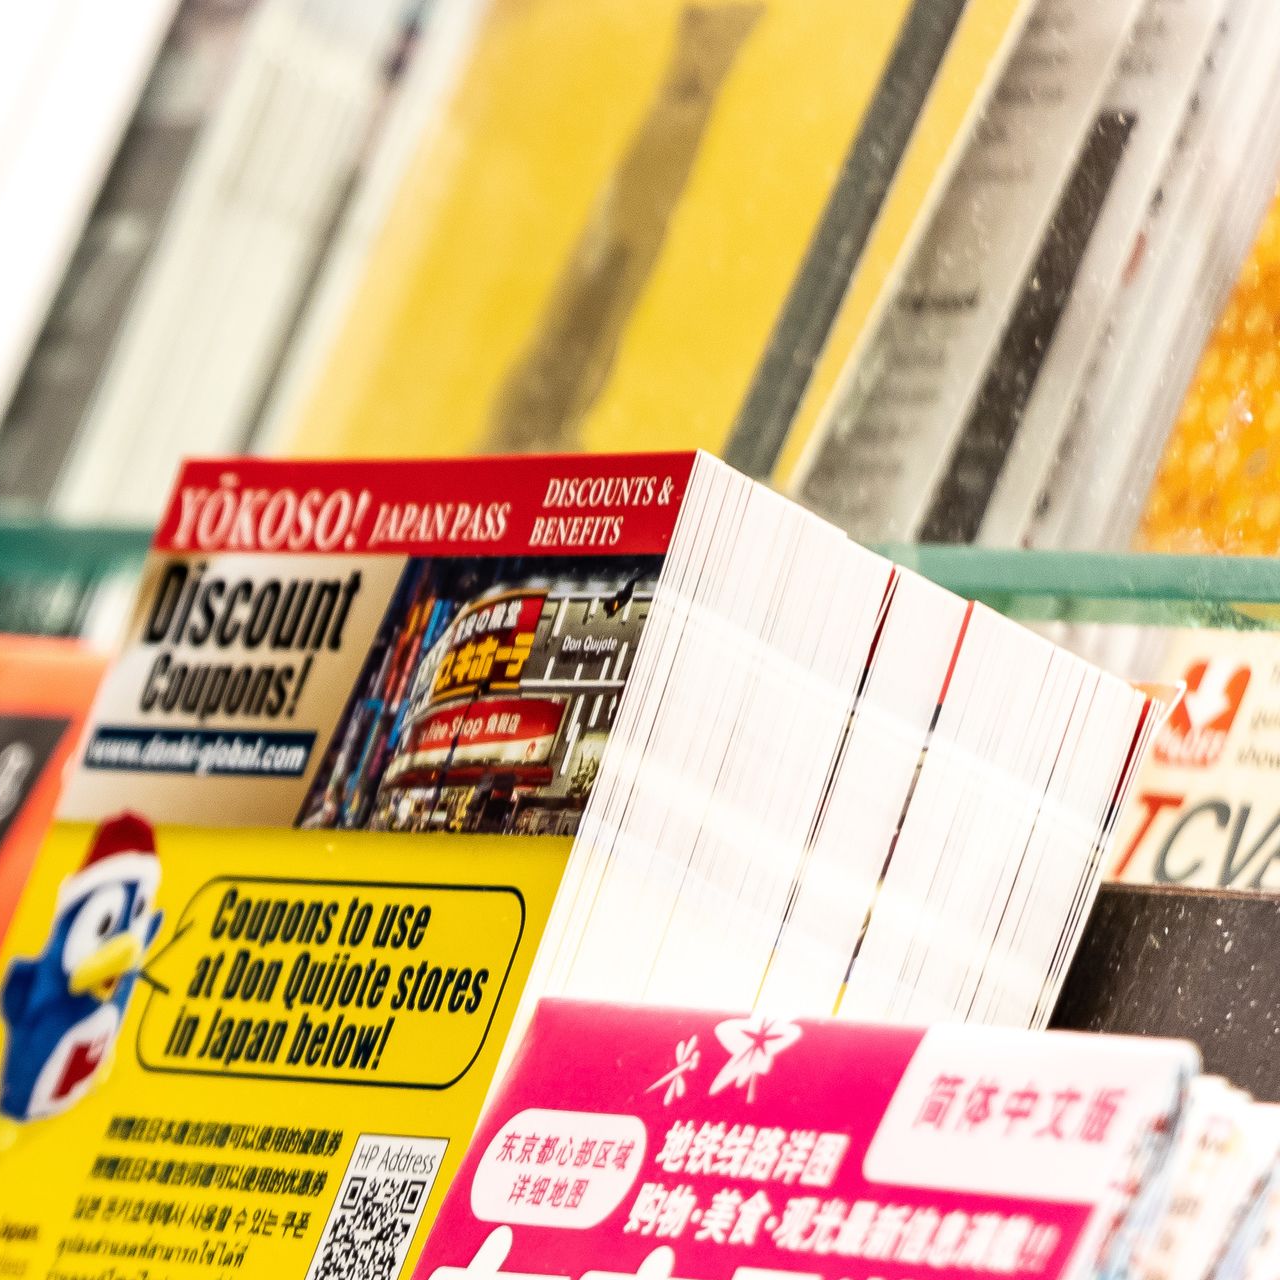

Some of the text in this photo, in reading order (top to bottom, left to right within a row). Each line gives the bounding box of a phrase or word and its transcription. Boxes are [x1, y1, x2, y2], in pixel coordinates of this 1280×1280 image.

[543, 476, 674, 509] DISCOUNTS &
[368, 503, 451, 545] JAPAN
[449, 501, 511, 541] PASS
[528, 516, 624, 547] BENEFITS
[144, 562, 361, 651] Discount
[562, 635, 618, 655] Don Quijote
[140, 652, 314, 724] Coupons!
[88, 733, 306, 777] www.donki-global.com
[210, 887, 431, 950] Coupons to use
[186, 953, 488, 1020] at Don Quijote stores
[164, 1008, 396, 1072] in Japan below!
[912, 1068, 1134, 1152] 简体中文版
[353, 1144, 438, 1176] HP Address
[496, 1130, 637, 1171] 东京都心部区域
[507, 1174, 590, 1210] 详细地图
[232, 1206, 249, 1236] 수
[249, 1207, 279, 1239] 있는
[278, 1210, 312, 1240] 쿠폰
